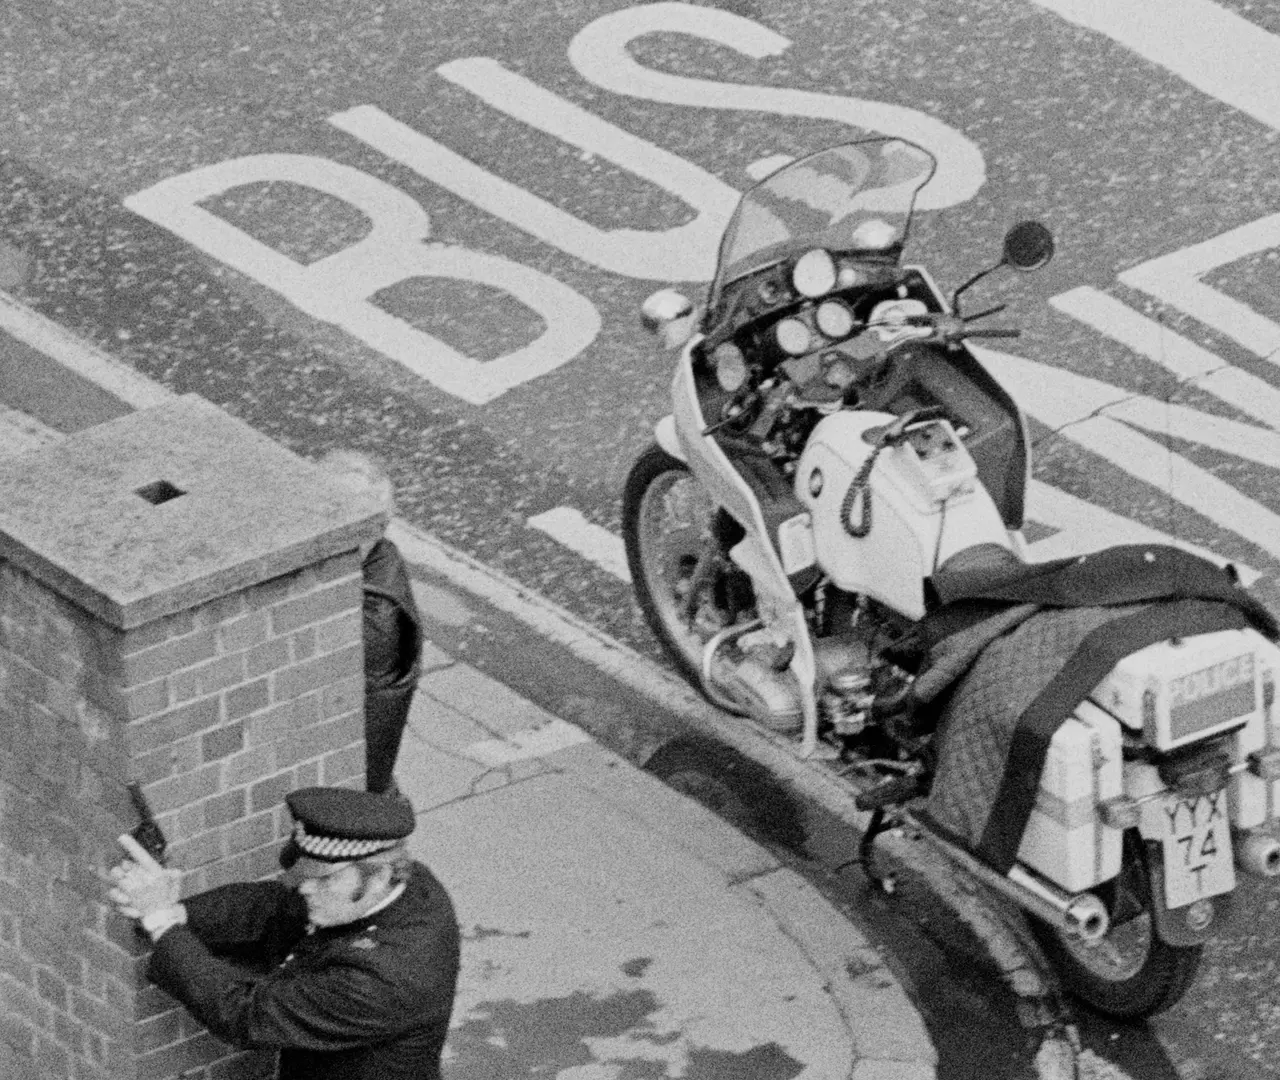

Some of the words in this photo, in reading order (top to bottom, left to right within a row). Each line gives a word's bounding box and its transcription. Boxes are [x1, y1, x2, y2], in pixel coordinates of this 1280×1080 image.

[124, 2, 986, 404] BUS
[1168, 652, 1255, 705] POLICE
[1177, 829, 1217, 865] 74
[1189, 863, 1208, 892] T
